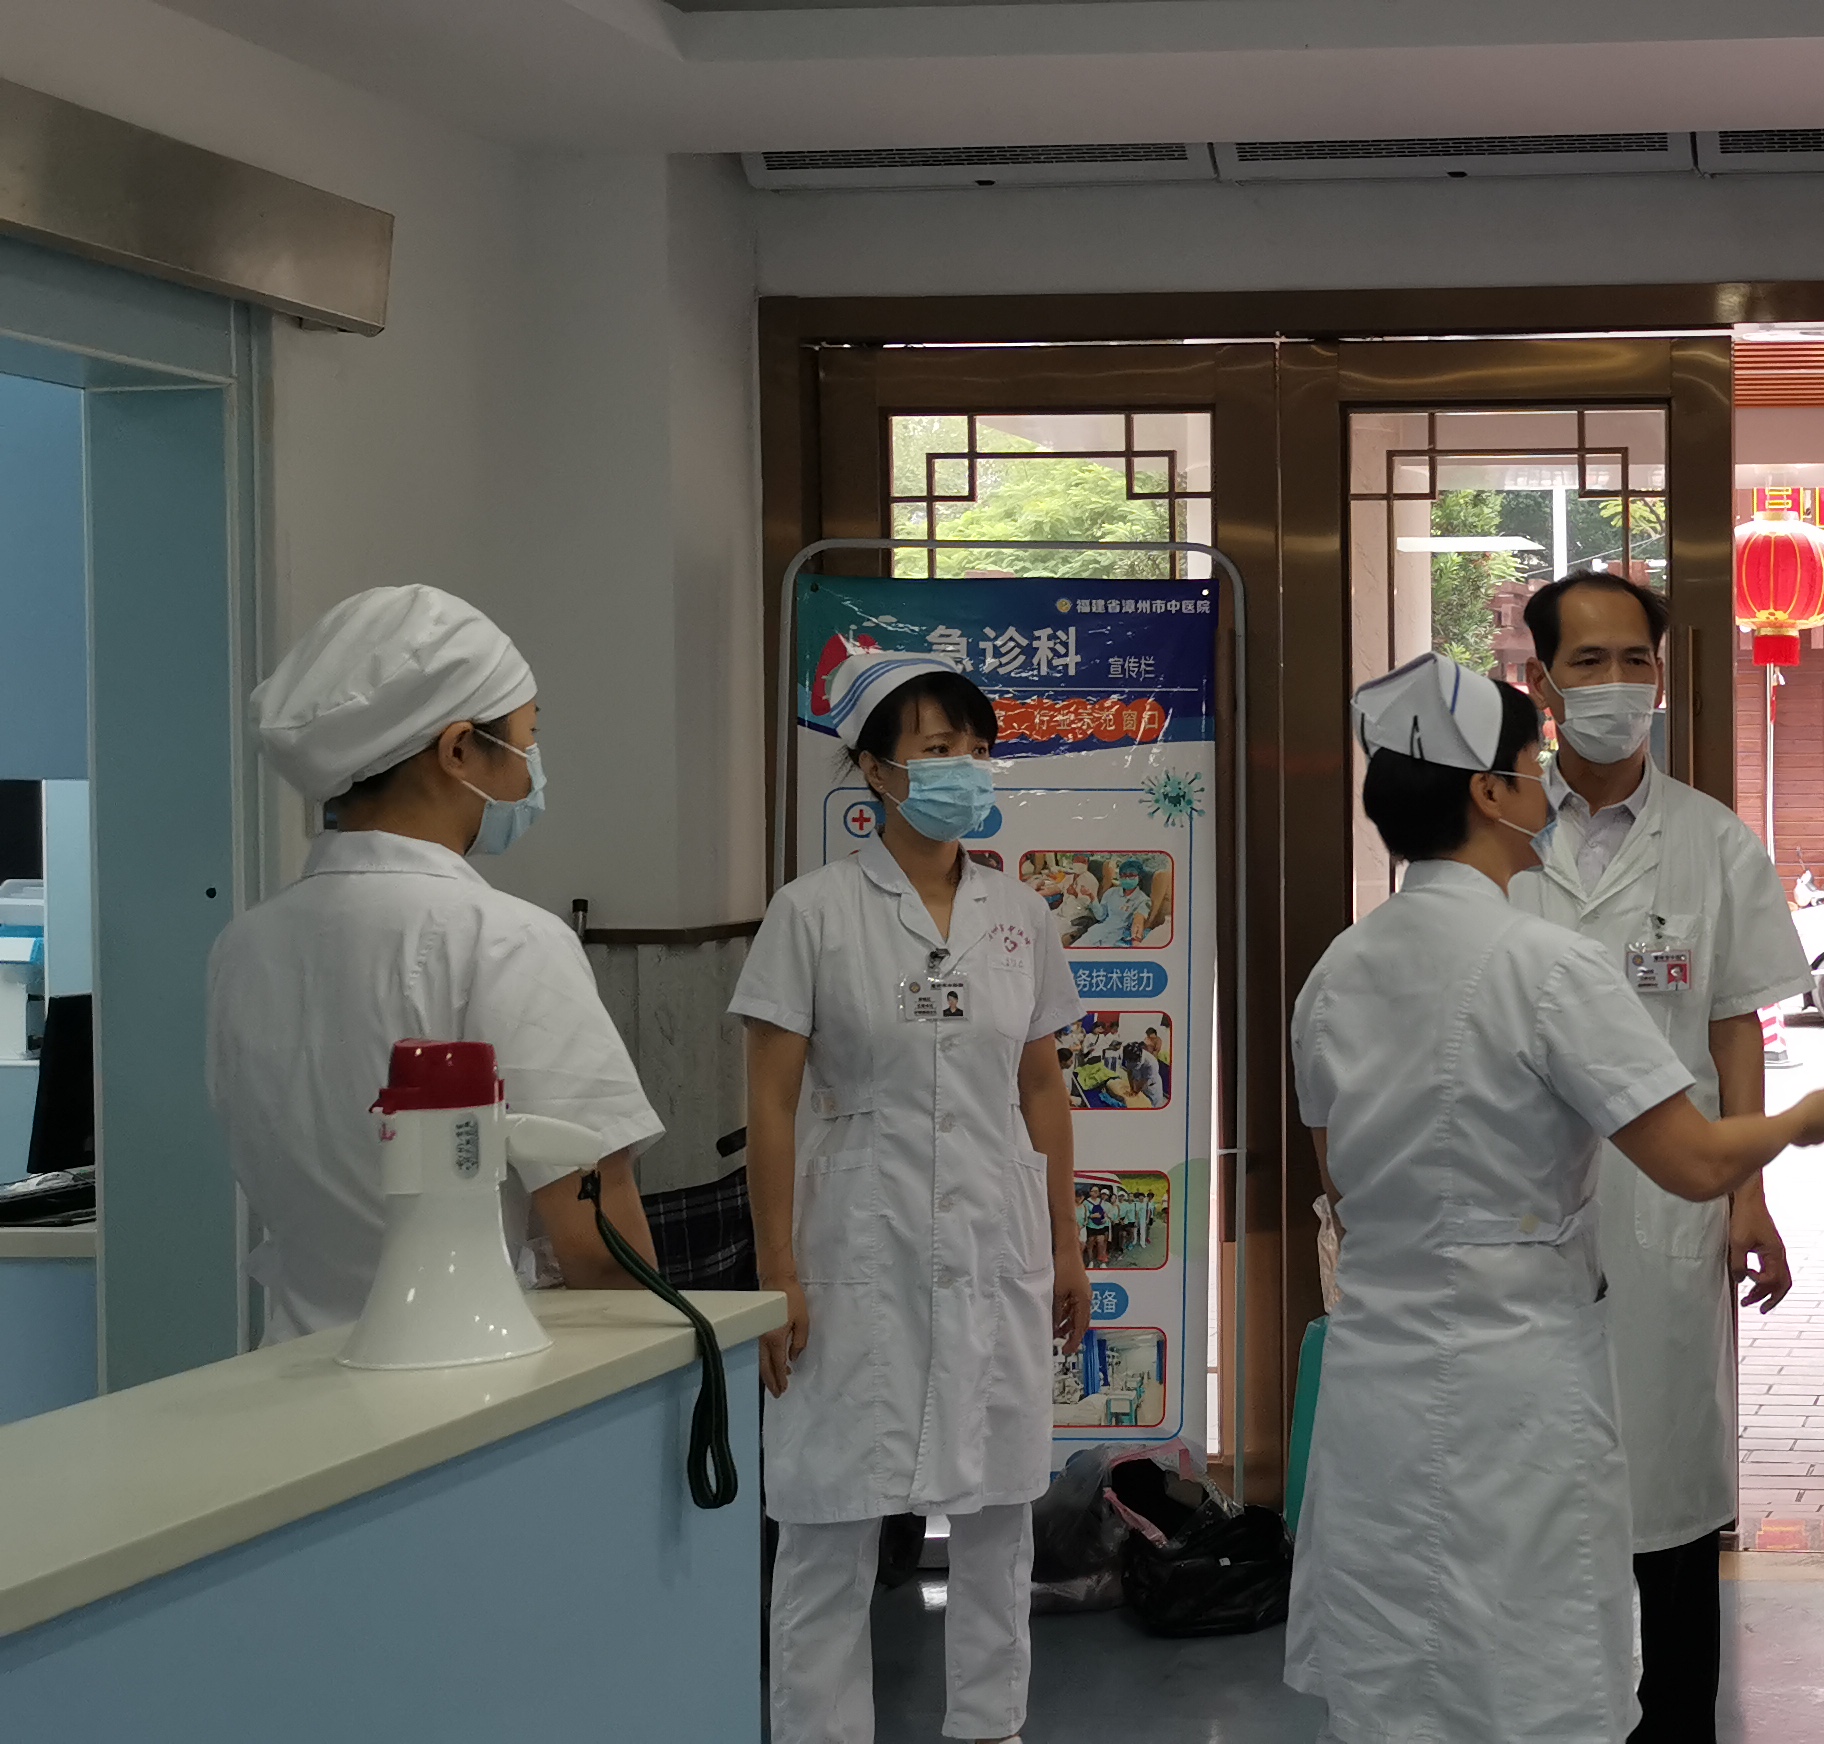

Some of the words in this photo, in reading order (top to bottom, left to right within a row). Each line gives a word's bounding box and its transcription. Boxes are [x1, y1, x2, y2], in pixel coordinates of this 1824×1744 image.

[1076, 599, 1210, 614] 福建省漳州市中医院
[926, 626, 1081, 676] 急诊科
[1108, 656, 1156, 679] 宣传栏
